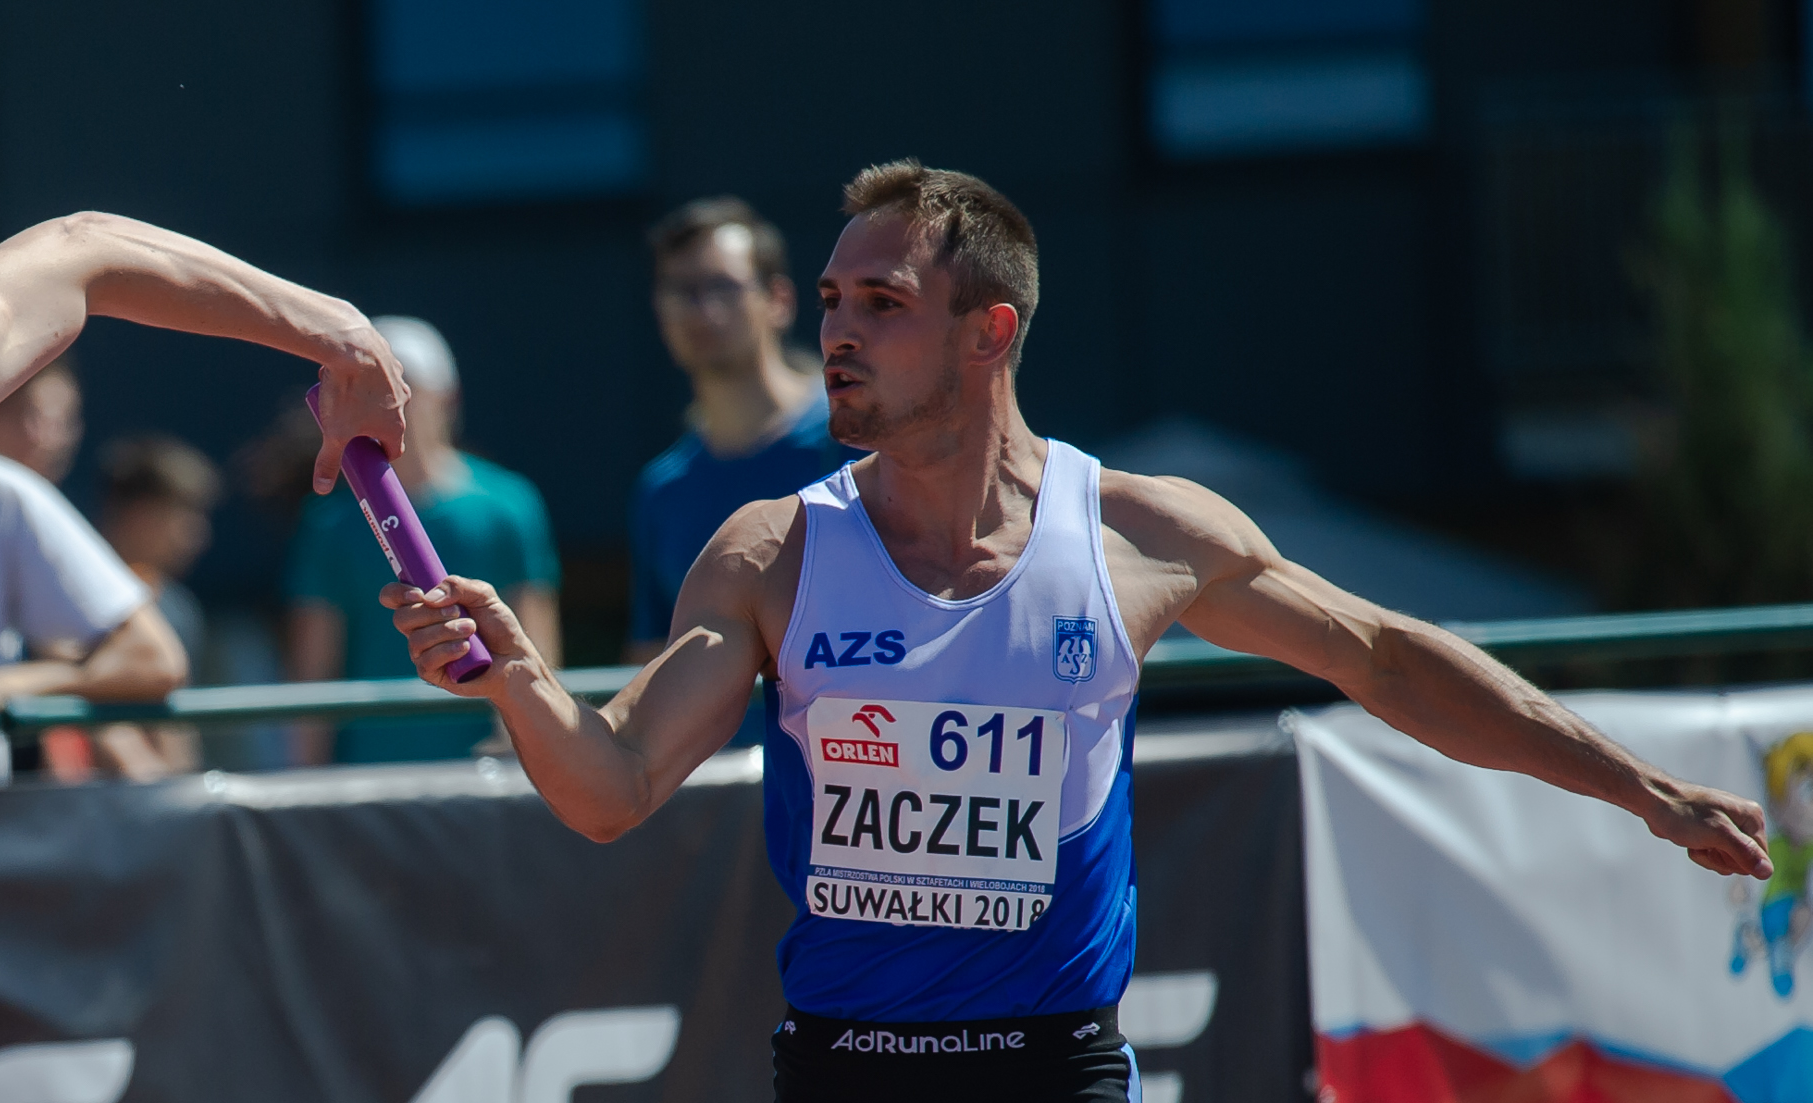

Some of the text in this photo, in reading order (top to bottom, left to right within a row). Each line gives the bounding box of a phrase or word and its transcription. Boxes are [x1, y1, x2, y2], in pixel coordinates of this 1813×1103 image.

[381, 515, 399, 532] 3
[804, 629, 906, 669] AZS
[825, 742, 894, 764] ORLEN
[930, 710, 1045, 776] 611
[821, 784, 1045, 861] ZACZEK
[814, 867, 832, 877] PZLA
[832, 869, 879, 882] MISTRZOSTWA
[879, 874, 906, 884] POLSKI
[907, 876, 915, 884] W
[916, 877, 964, 887] SZTAFETACH
[969, 880, 1027, 891] WIELOBOJACH
[814, 882, 1045, 928] SUWAŁKI 2018
